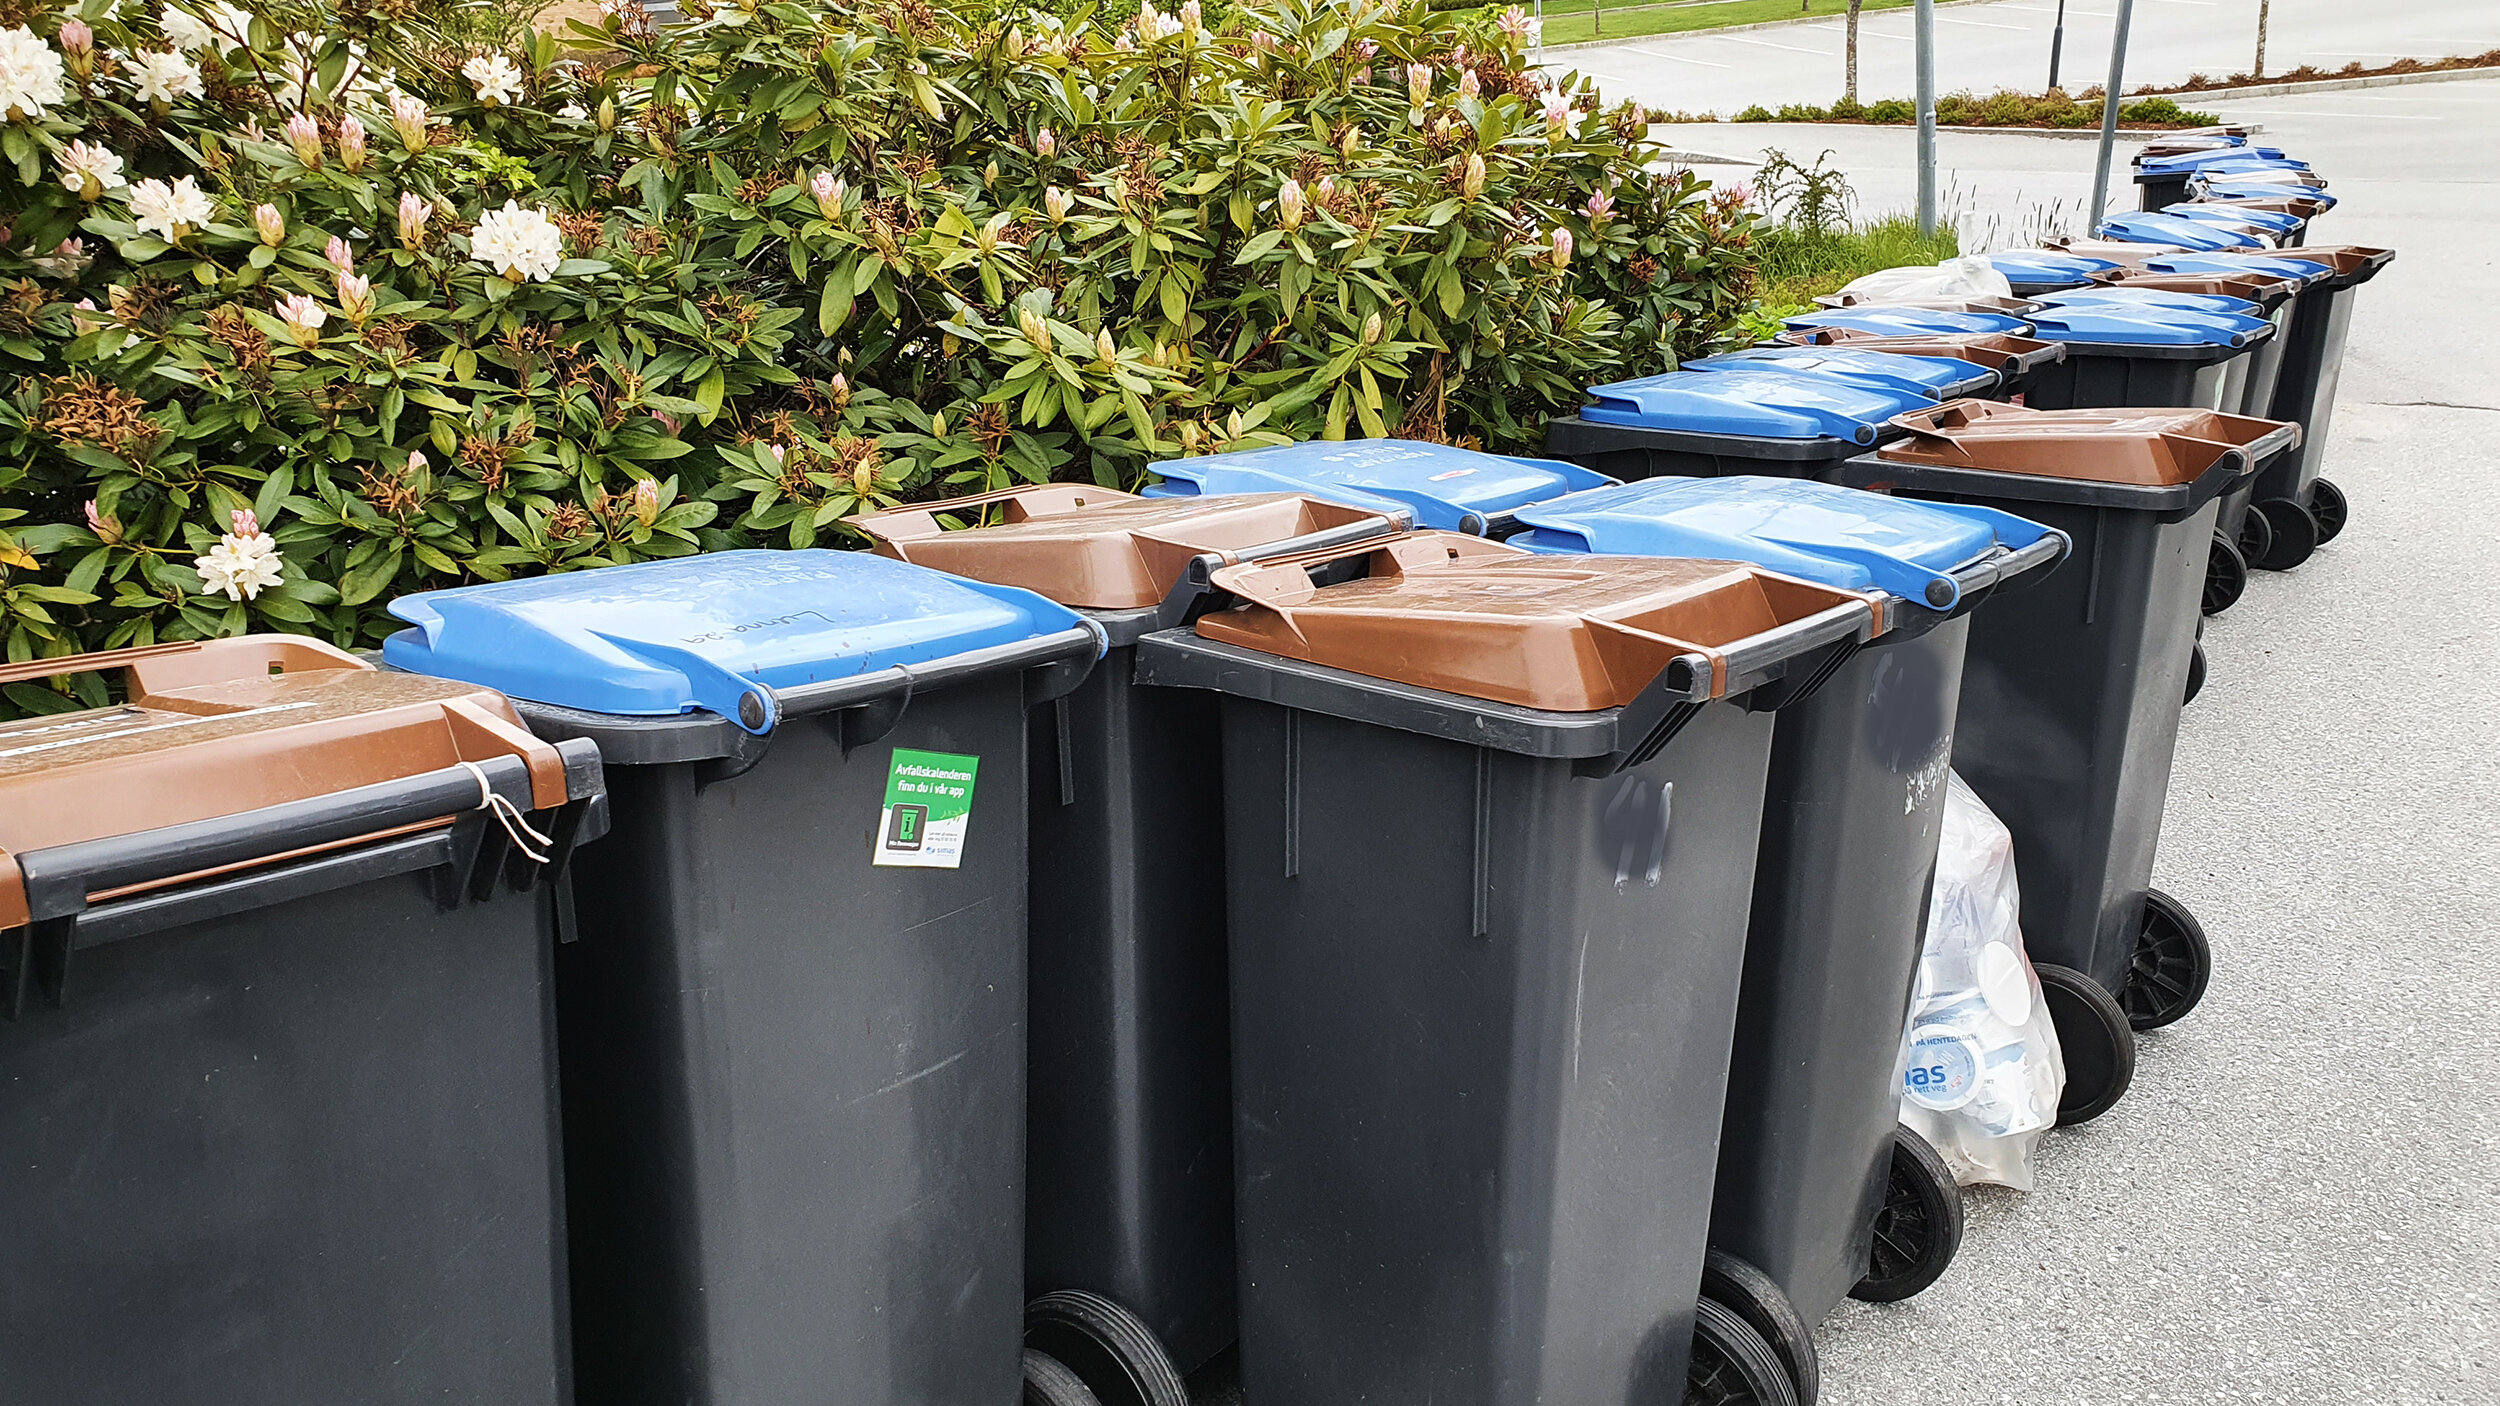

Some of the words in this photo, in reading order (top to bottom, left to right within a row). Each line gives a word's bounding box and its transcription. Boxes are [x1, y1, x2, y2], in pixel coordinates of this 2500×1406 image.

[895, 763, 972, 781] Avfallskalenderen
[898, 779, 915, 792] finn
[917, 782, 929, 793] du
[929, 783, 935, 793] i
[935, 783, 949, 794] vår
[949, 787, 965, 798] app
[1916, 1039, 1927, 1047] PÅ
[1914, 1085, 1929, 1093] rett
